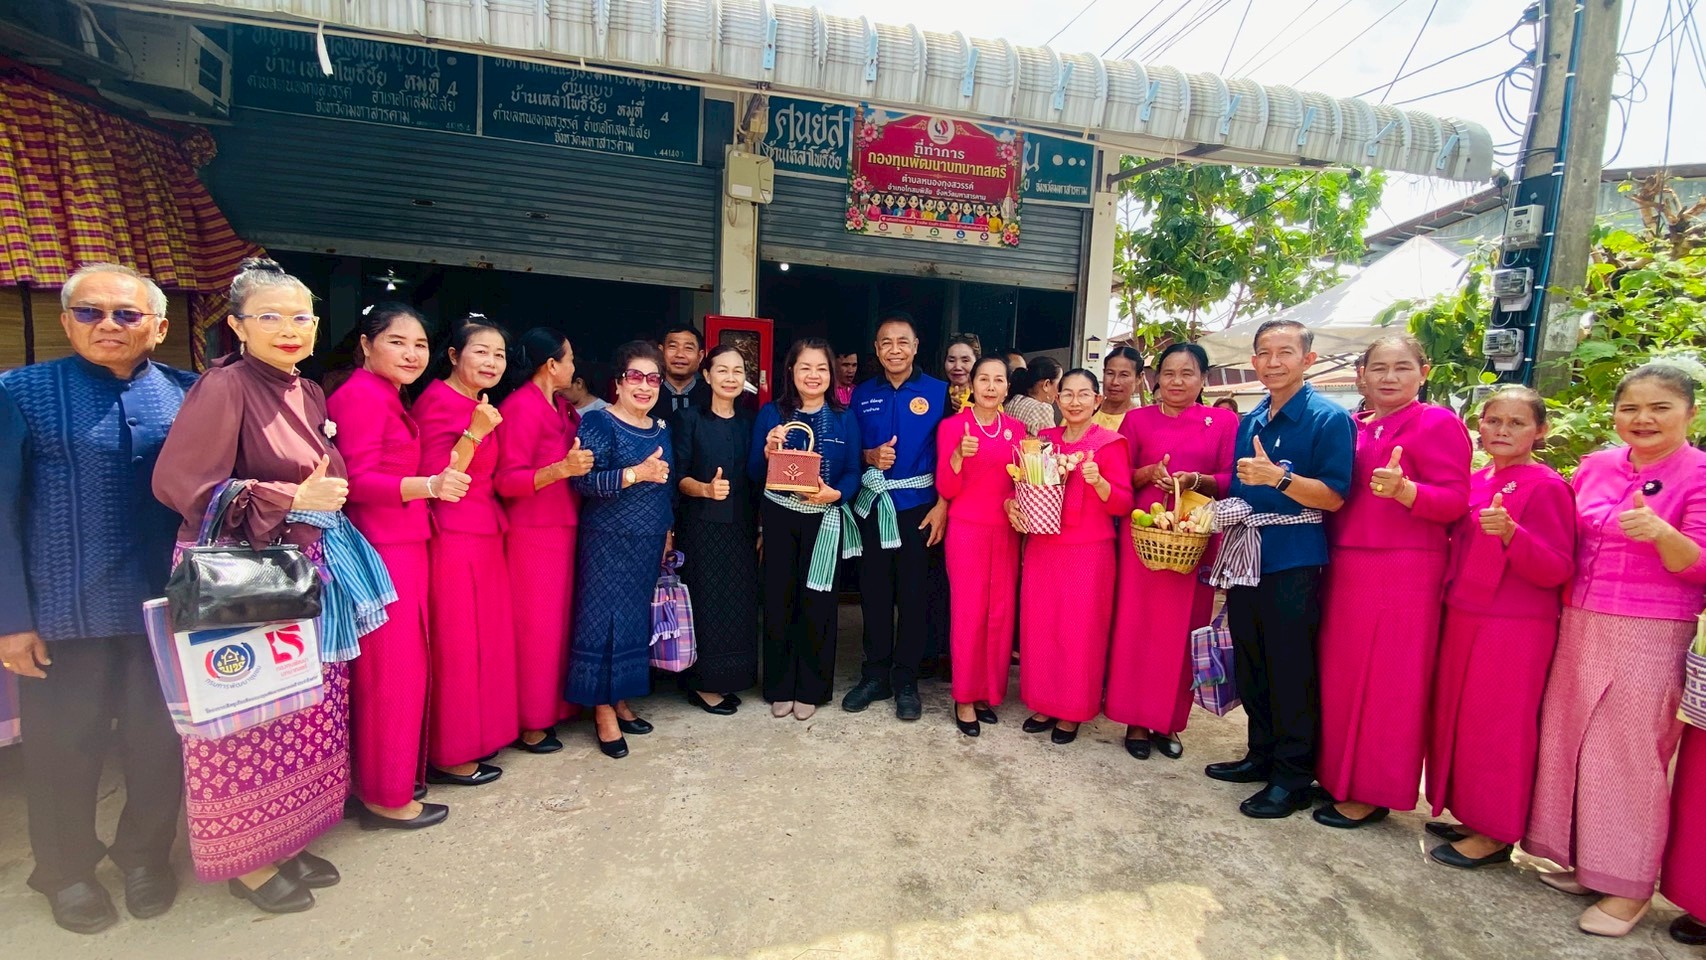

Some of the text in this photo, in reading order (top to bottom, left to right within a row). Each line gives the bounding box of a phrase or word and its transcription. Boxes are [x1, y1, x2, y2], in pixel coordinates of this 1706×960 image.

[447, 81, 459, 97] 4
[562, 78, 613, 98] ต้นแบบ
[617, 97, 645, 126] หมู่ที่
[660, 112, 670, 123] 4
[914, 138, 965, 160] ที่ทำการ
[868, 150, 1007, 179] กองทุนพัฒนาบทบาทสตรี
[901, 174, 974, 190] ตำบลหนองกุงสวรรค์
